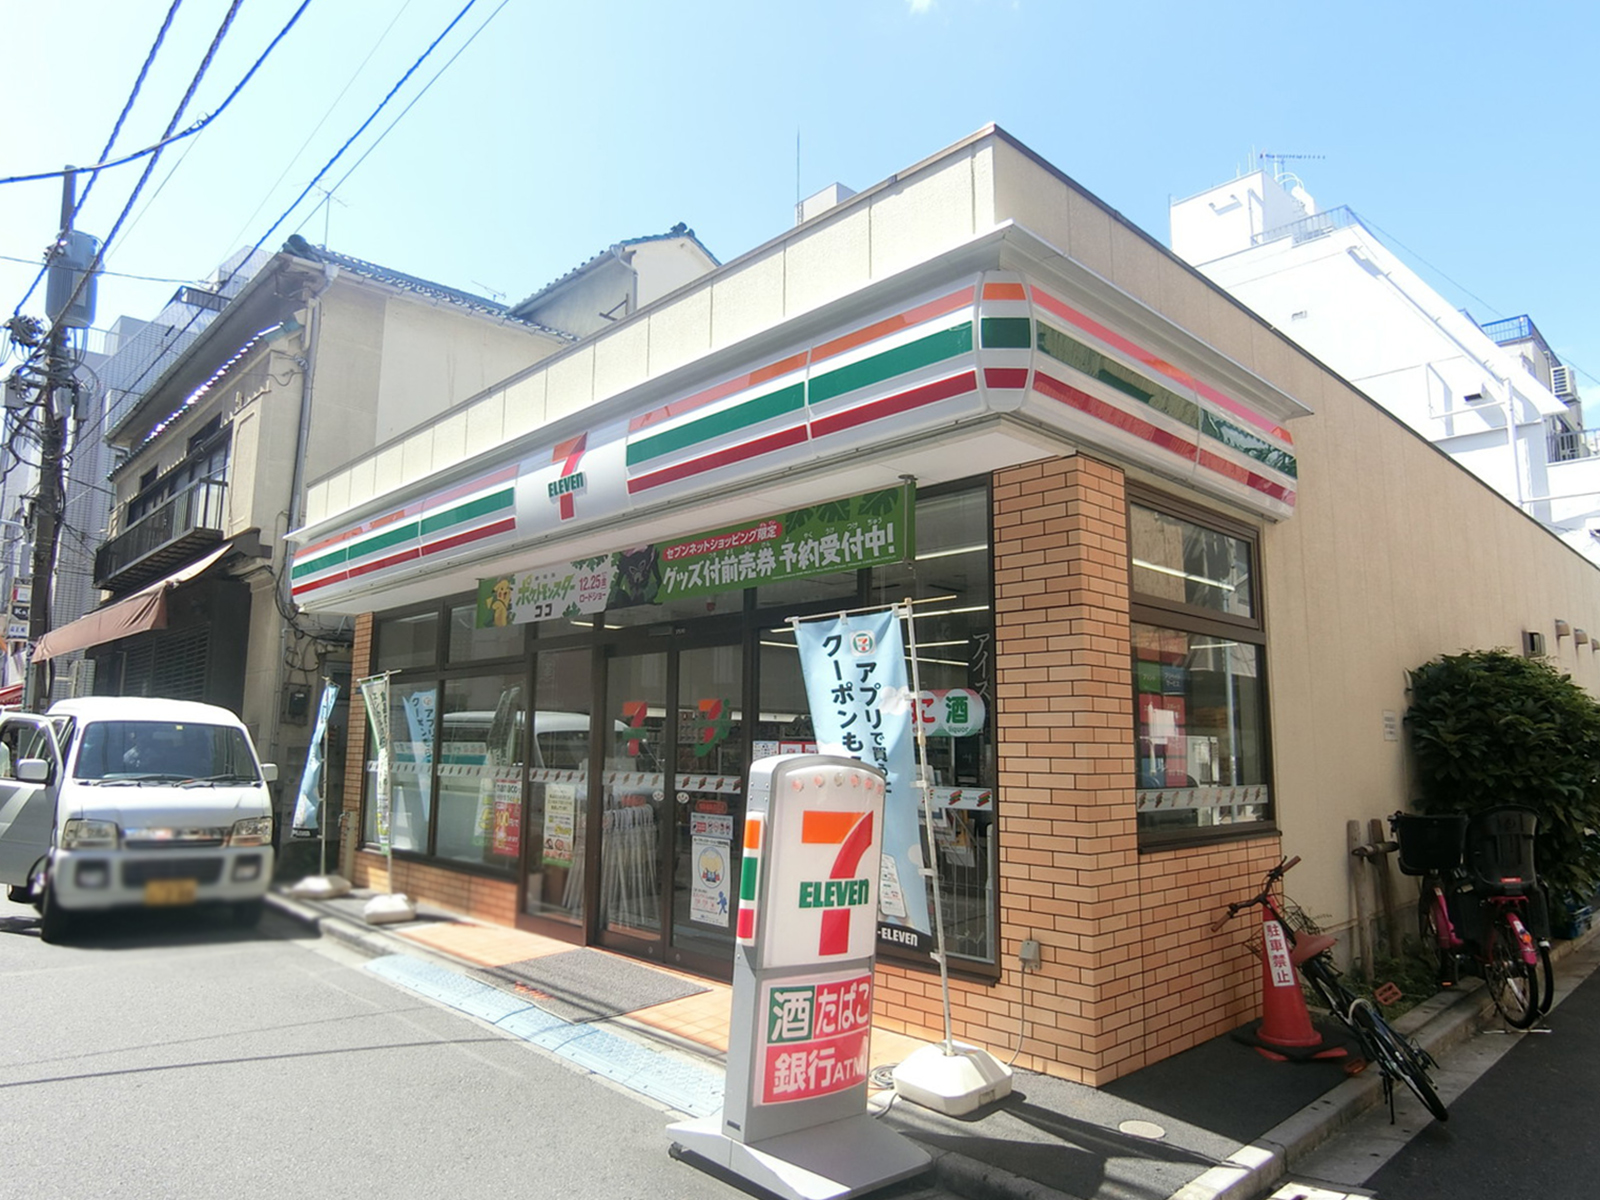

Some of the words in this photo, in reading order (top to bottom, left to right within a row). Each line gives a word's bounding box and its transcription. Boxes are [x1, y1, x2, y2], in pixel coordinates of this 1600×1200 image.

[663, 547, 777, 594] グッズ付前売券
[666, 525, 777, 559] セブンネットショッピング限定
[534, 603, 553, 618] ココ
[973, 633, 991, 701] アイス
[822, 634, 863, 760] クーポンも
[945, 696, 969, 723] 酒
[801, 810, 874, 956] 7
[1266, 924, 1291, 983] 駐車禁止
[771, 990, 813, 1041] 酒
[815, 981, 870, 1036] たばこ
